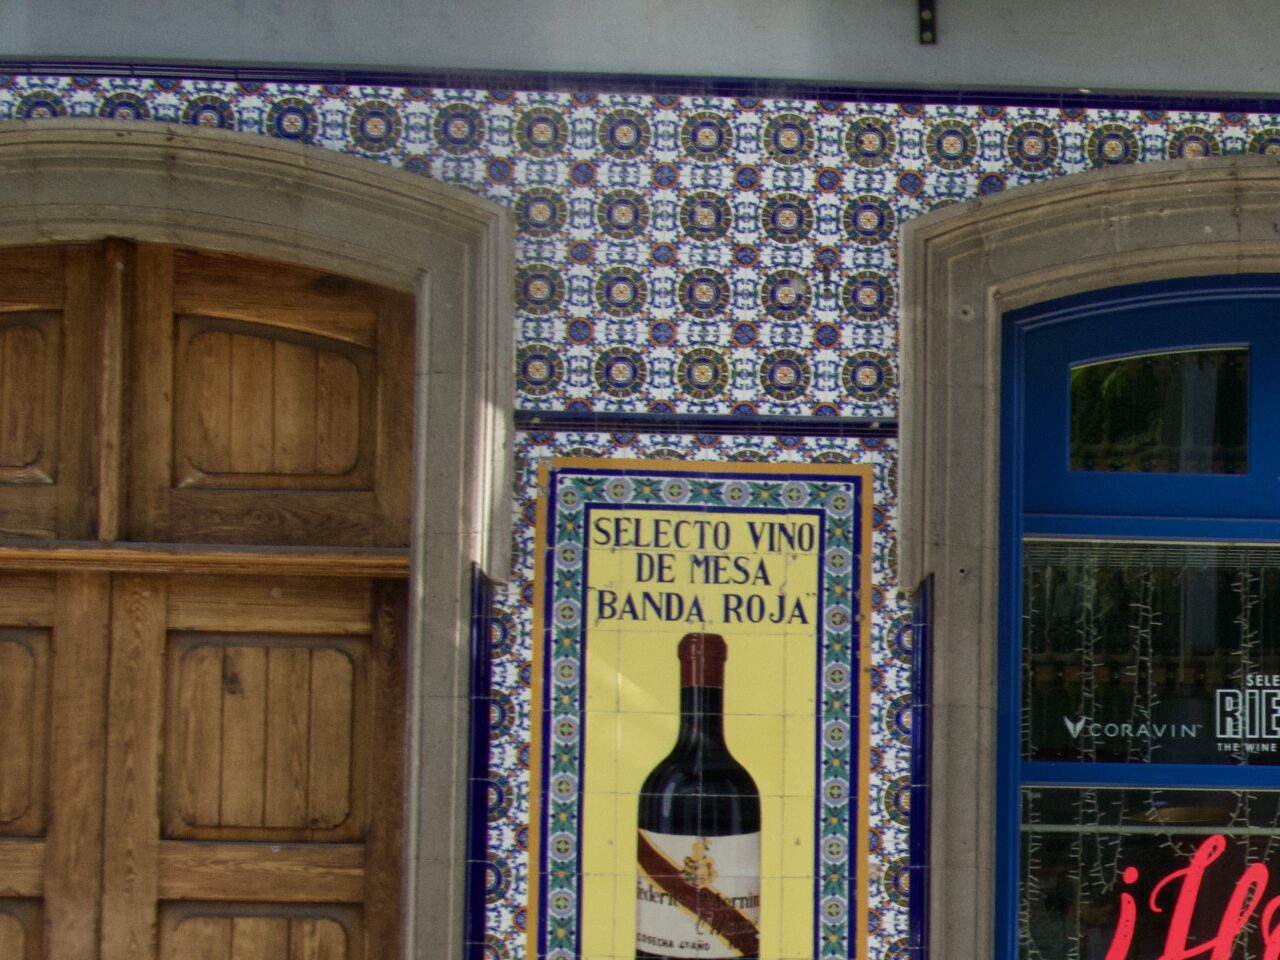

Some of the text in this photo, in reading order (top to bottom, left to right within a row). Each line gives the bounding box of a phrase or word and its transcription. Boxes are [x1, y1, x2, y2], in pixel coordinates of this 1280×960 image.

[593, 517, 815, 553] SELECTO VINO
[636, 553, 771, 586] DE MESA
[1217, 743, 1239, 751] THE
[1244, 743, 1277, 752] WINE
